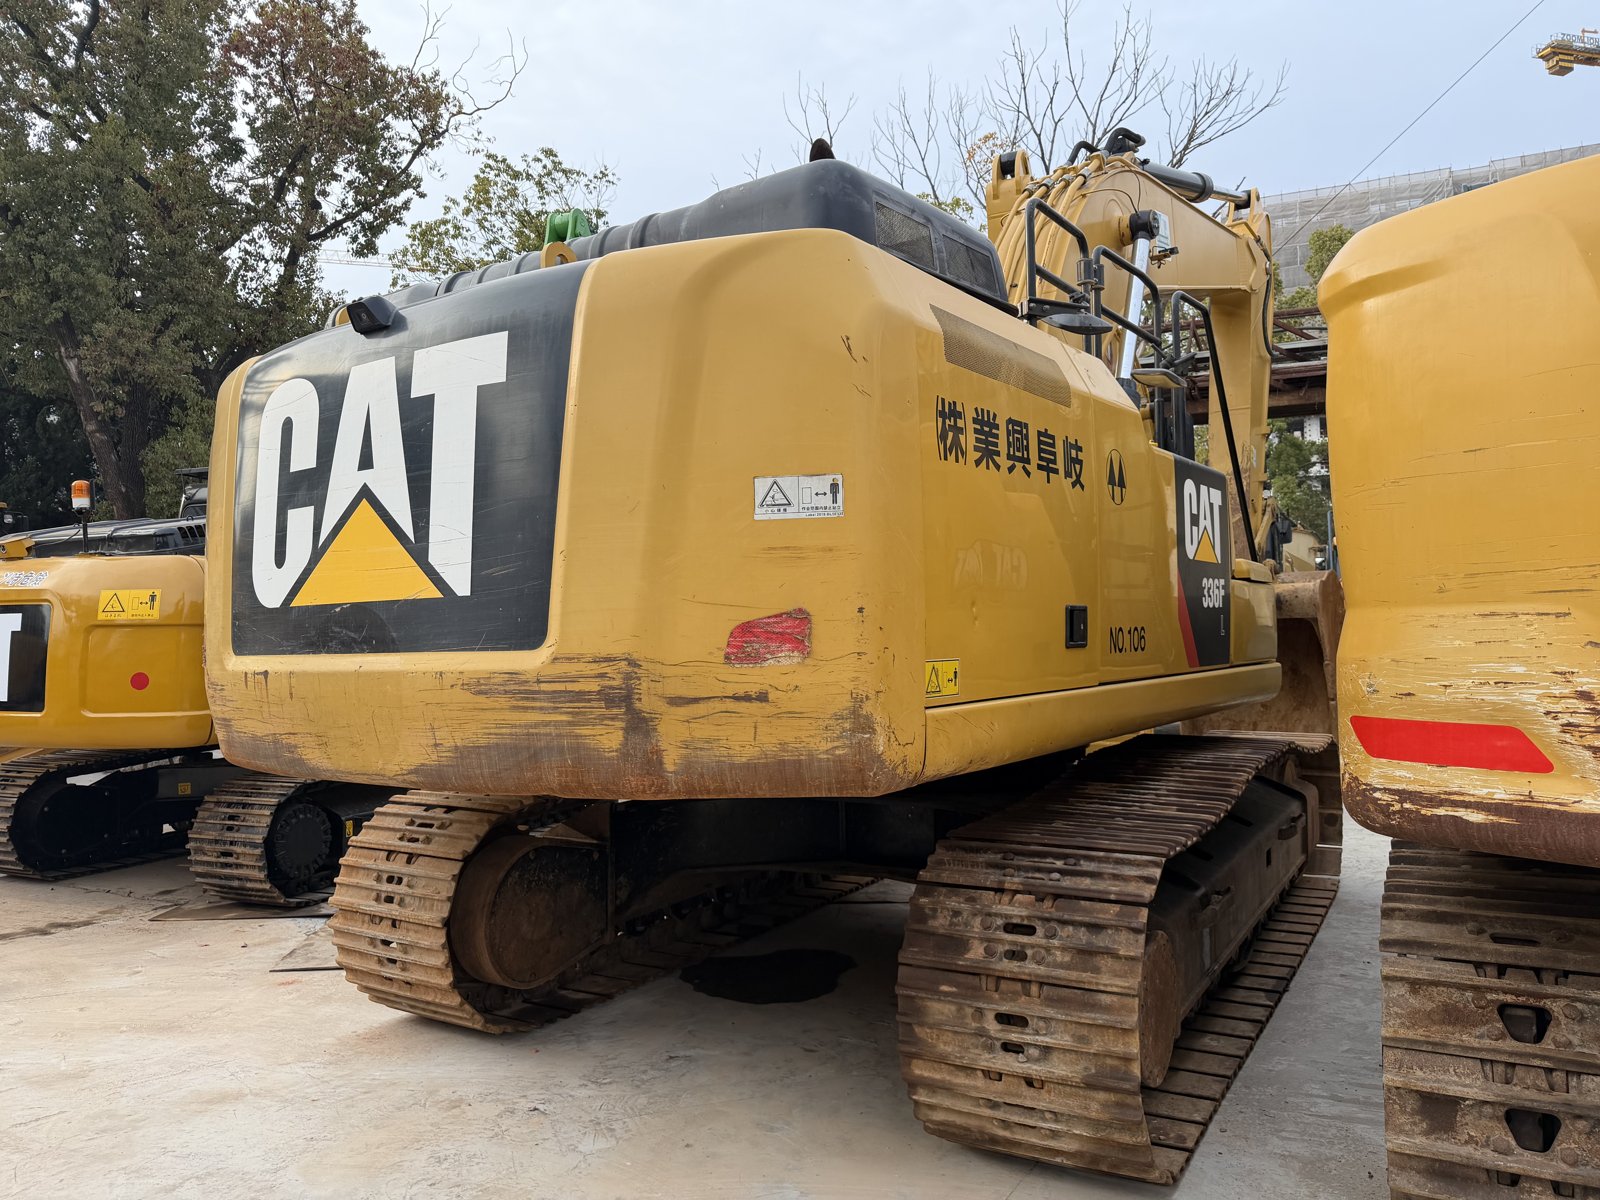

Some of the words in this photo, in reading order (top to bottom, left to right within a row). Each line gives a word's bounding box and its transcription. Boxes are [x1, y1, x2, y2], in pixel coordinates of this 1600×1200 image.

[252, 331, 508, 608] CAT
[1184, 479, 1222, 564] CAT
[1202, 577, 1225, 609] 336F
[1109, 626, 1147, 654] NO.106
